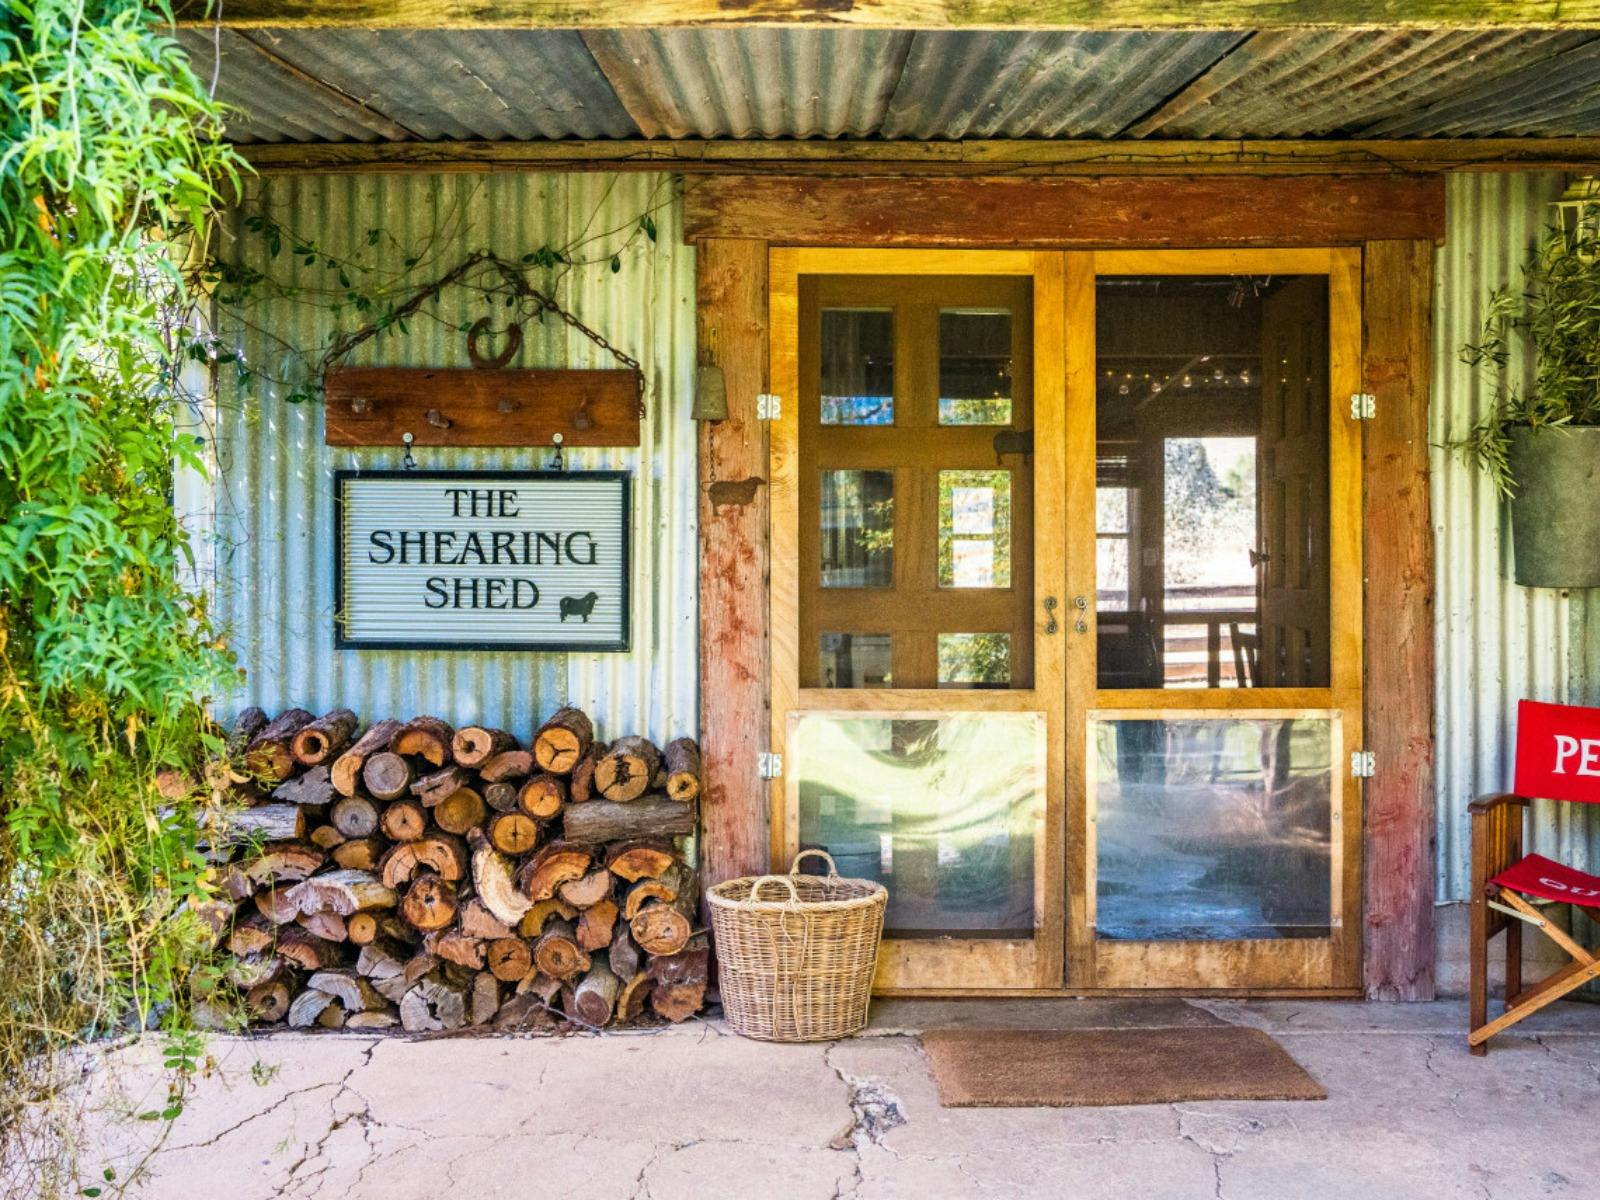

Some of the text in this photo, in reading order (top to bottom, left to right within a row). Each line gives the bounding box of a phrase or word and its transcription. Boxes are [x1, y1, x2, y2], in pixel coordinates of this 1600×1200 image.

[445, 489, 520, 518] THE
[368, 530, 598, 565] SHEARING
[424, 577, 540, 609] SHED
